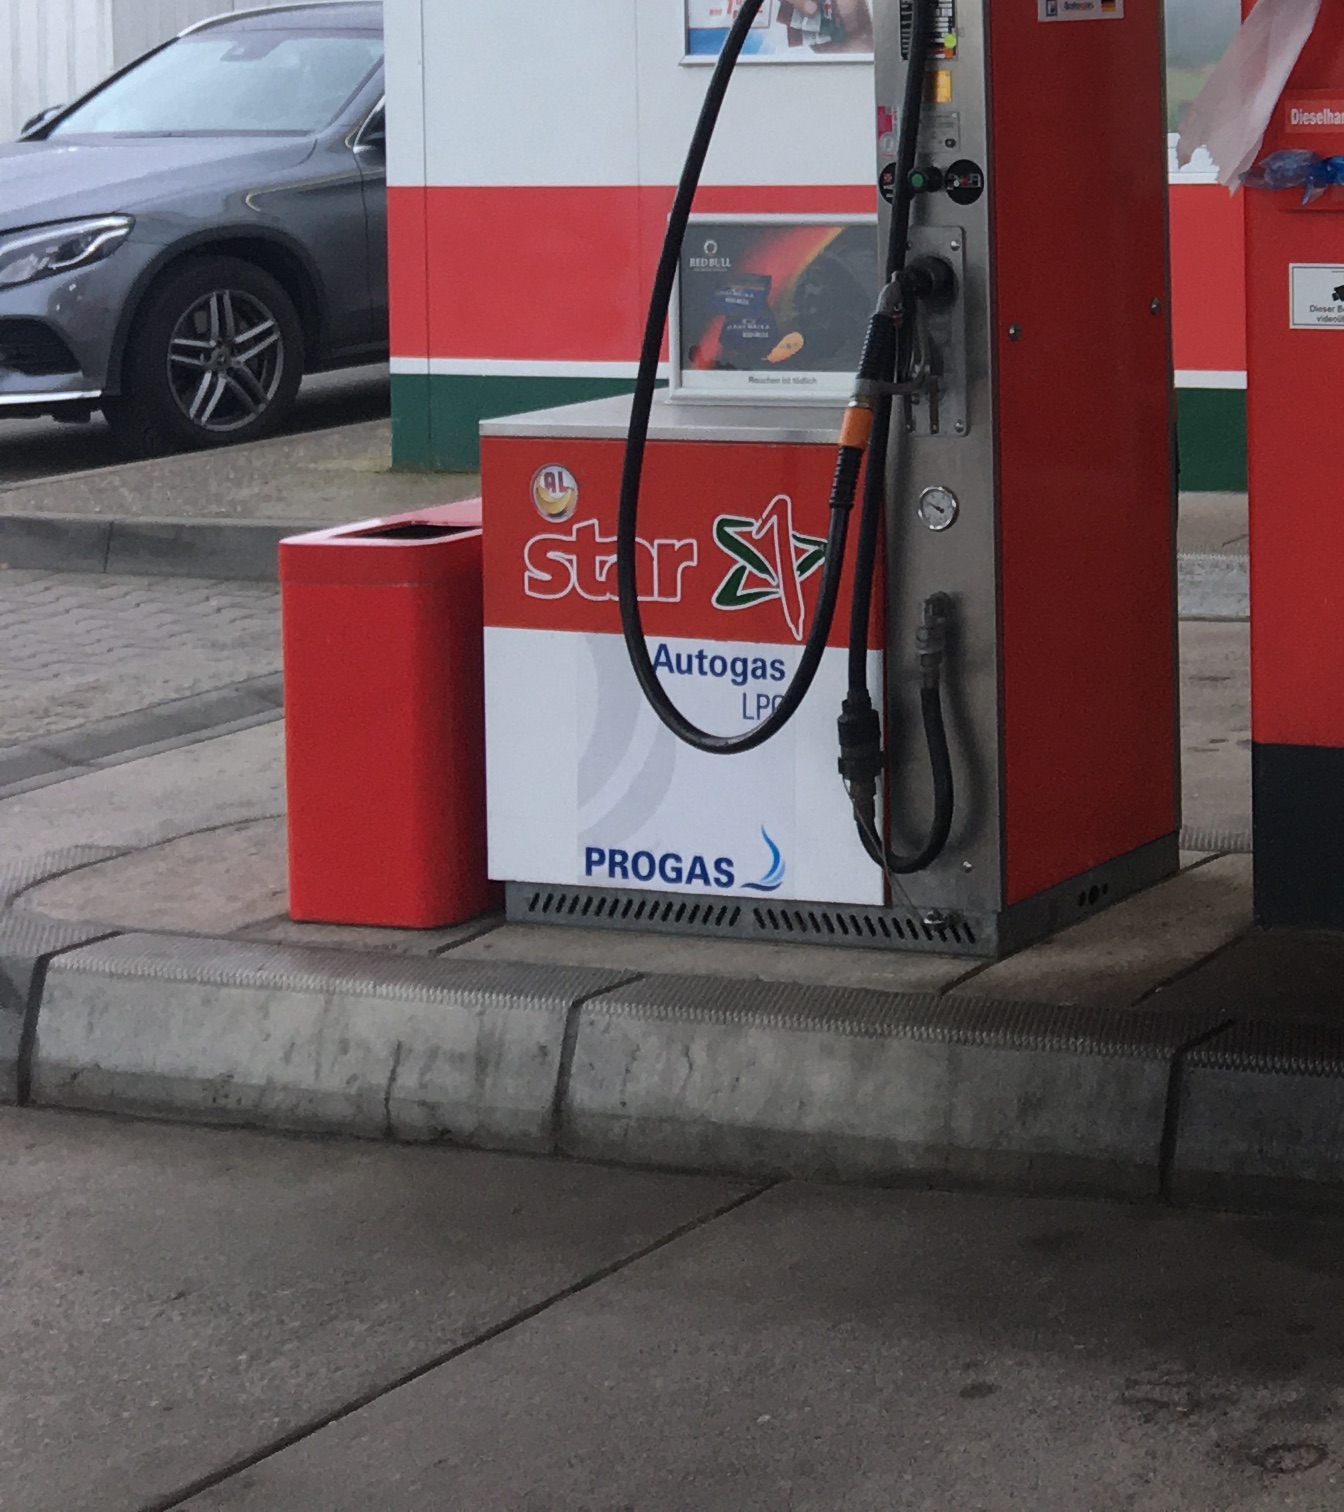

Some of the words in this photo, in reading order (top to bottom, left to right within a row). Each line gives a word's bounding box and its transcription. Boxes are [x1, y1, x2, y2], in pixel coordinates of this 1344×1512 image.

[1309, 304, 1335, 313] Dieser
[524, 518, 698, 603] star
[653, 643, 785, 686] Autogas
[584, 846, 735, 887] PROGAS
